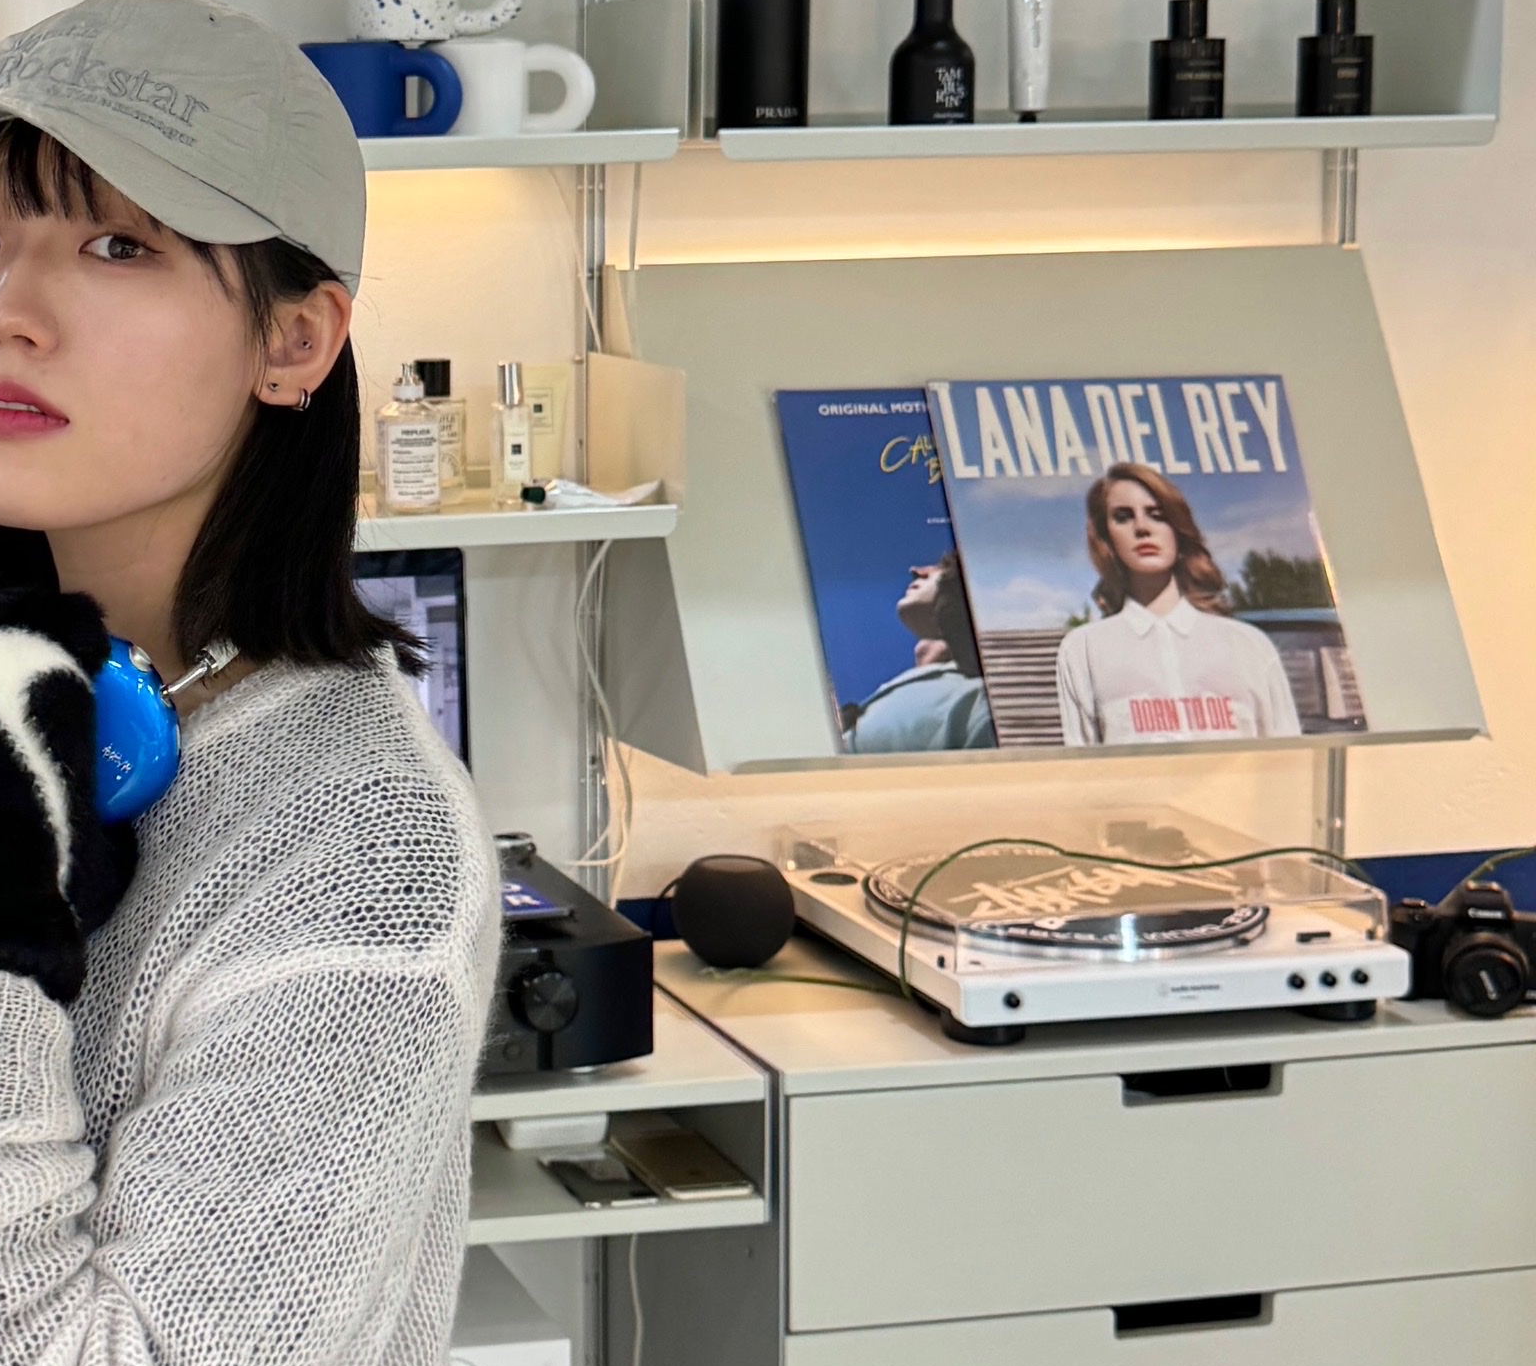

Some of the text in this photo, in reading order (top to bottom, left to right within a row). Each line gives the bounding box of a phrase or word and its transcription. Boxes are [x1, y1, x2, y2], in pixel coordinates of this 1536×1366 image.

[818, 402, 889, 417] ORIGINAL
[928, 379, 1288, 479] LANA DEL REY
